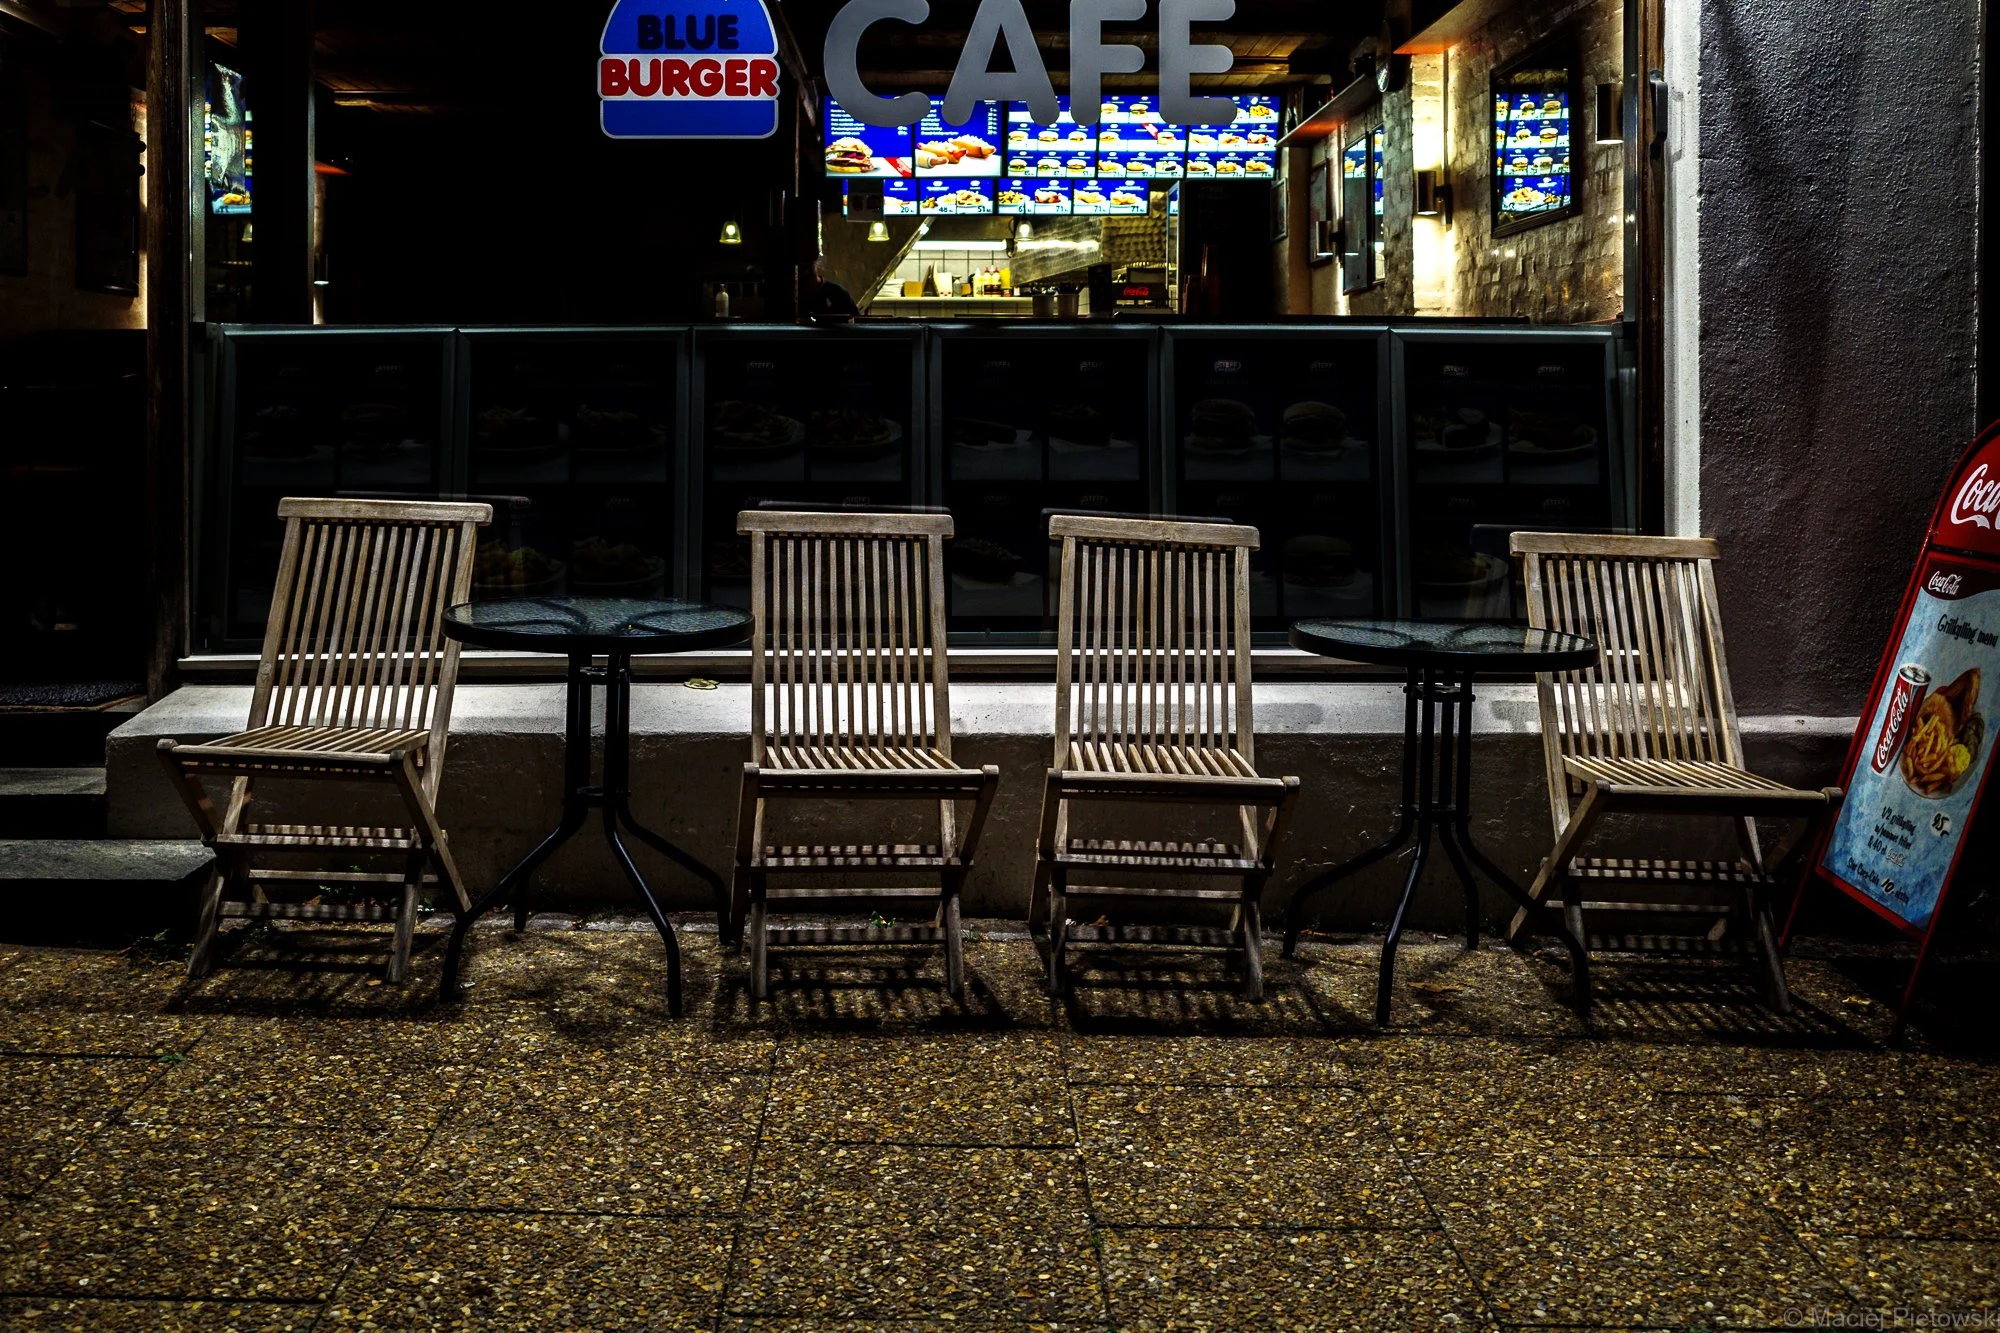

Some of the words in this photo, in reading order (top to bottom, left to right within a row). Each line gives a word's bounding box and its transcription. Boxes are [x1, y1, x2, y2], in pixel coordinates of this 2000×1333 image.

[638, 14, 739, 50] BLUE
[601, 58, 778, 97] BURGER
[1937, 614, 1979, 645] Grillkylling
[1977, 630, 1999, 648] menu
